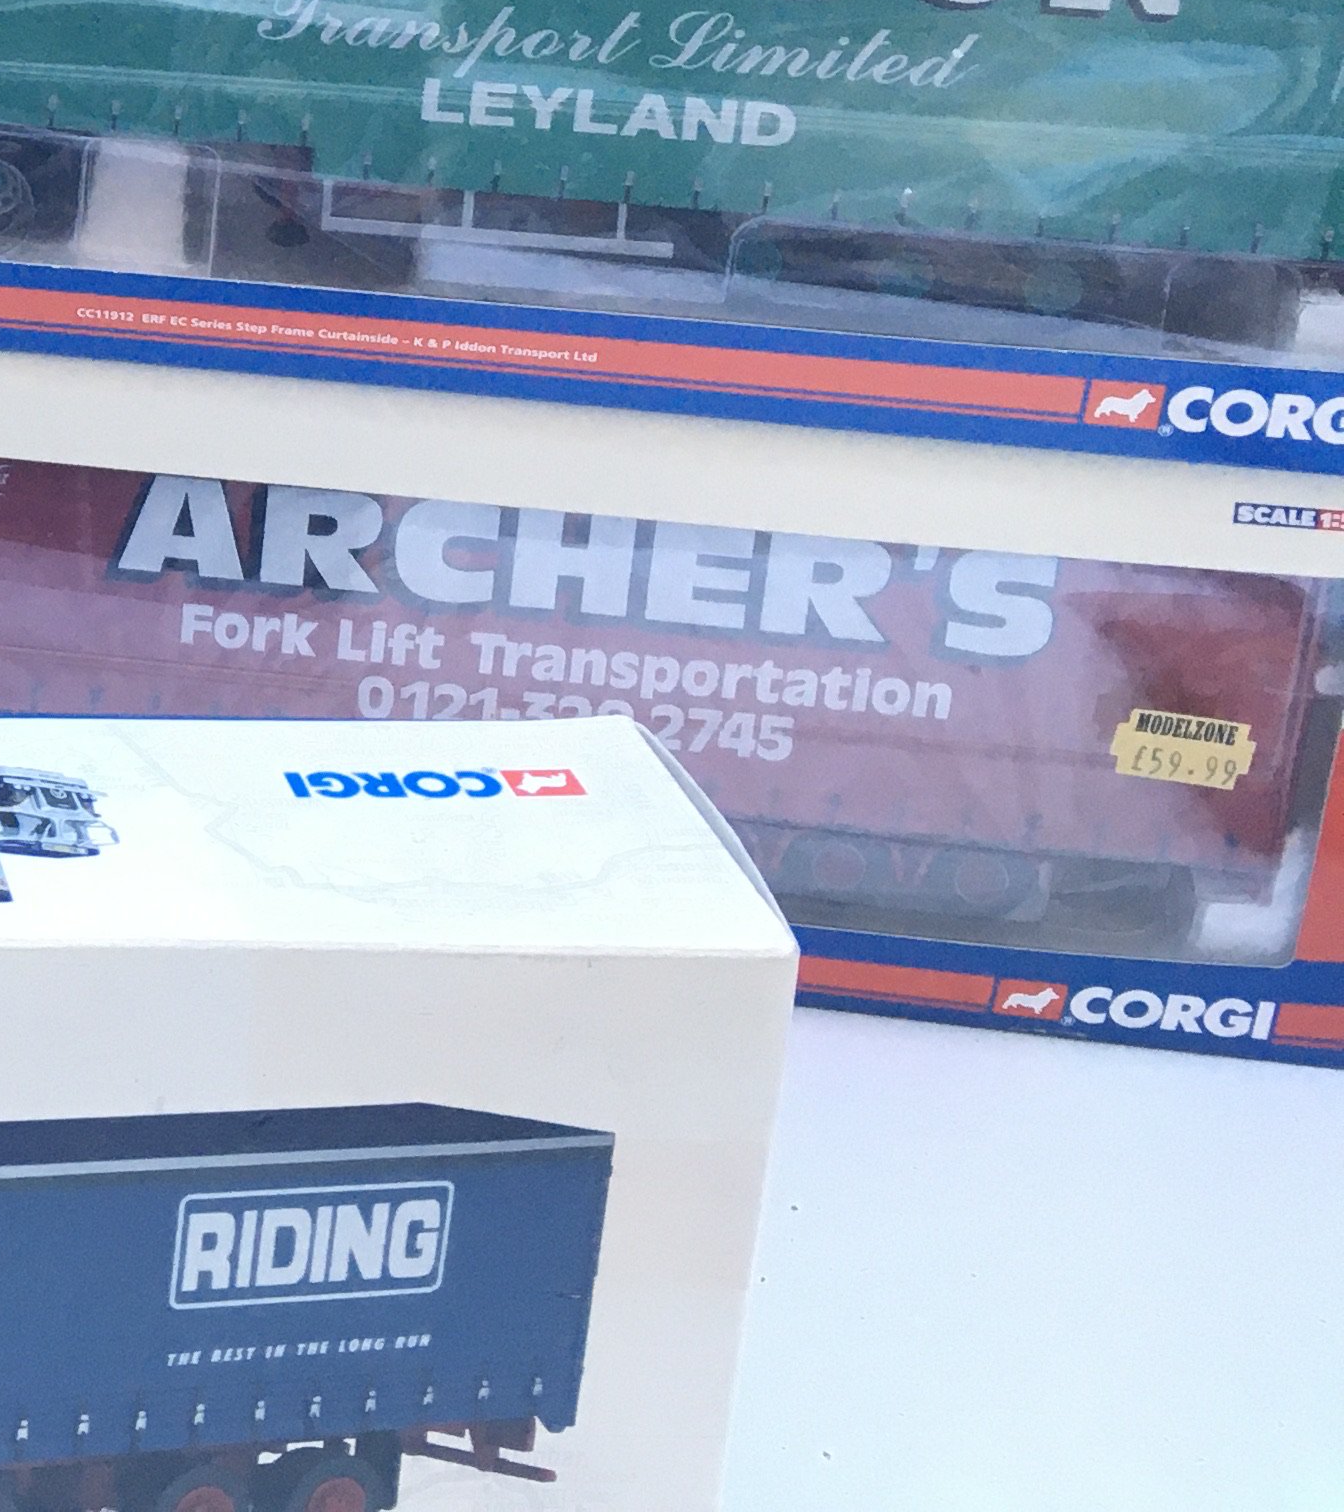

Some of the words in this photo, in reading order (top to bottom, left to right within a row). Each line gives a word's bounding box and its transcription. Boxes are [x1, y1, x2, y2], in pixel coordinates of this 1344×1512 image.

[648, 10, 981, 89] Limited
[421, 77, 797, 148] LEYLAND
[76, 306, 135, 322] CC11912
[141, 312, 166, 325] ERF
[170, 314, 188, 327] EC
[190, 315, 233, 330] Series
[235, 320, 267, 337] Step
[271, 324, 315, 338] Frame
[317, 327, 399, 345] Curtainside
[413, 335, 424, 346] K
[427, 336, 438, 348] &
[454, 338, 497, 353] Iddon
[500, 342, 569, 361] Transport
[572, 349, 598, 363] Ltd
[1236, 504, 1316, 527] SCALE
[116, 474, 1060, 659] ARCHER'S
[180, 602, 320, 660] Fork
[337, 617, 446, 672] Lift
[469, 631, 954, 722] Transportation
[649, 704, 796, 762] 2745
[1135, 712, 1240, 748] MODELZONE
[283, 769, 504, 800] CORGI
[1129, 743, 1240, 788] £59.99
[1070, 985, 1277, 1042] CORGI
[181, 1198, 441, 1292] RIDING
[167, 1352, 202, 1367] THE
[211, 1346, 257, 1363] BEST
[264, 1344, 286, 1359] IN
[296, 1340, 329, 1356] THE
[338, 1337, 386, 1353] LONG
[394, 1334, 433, 1350] RUN
